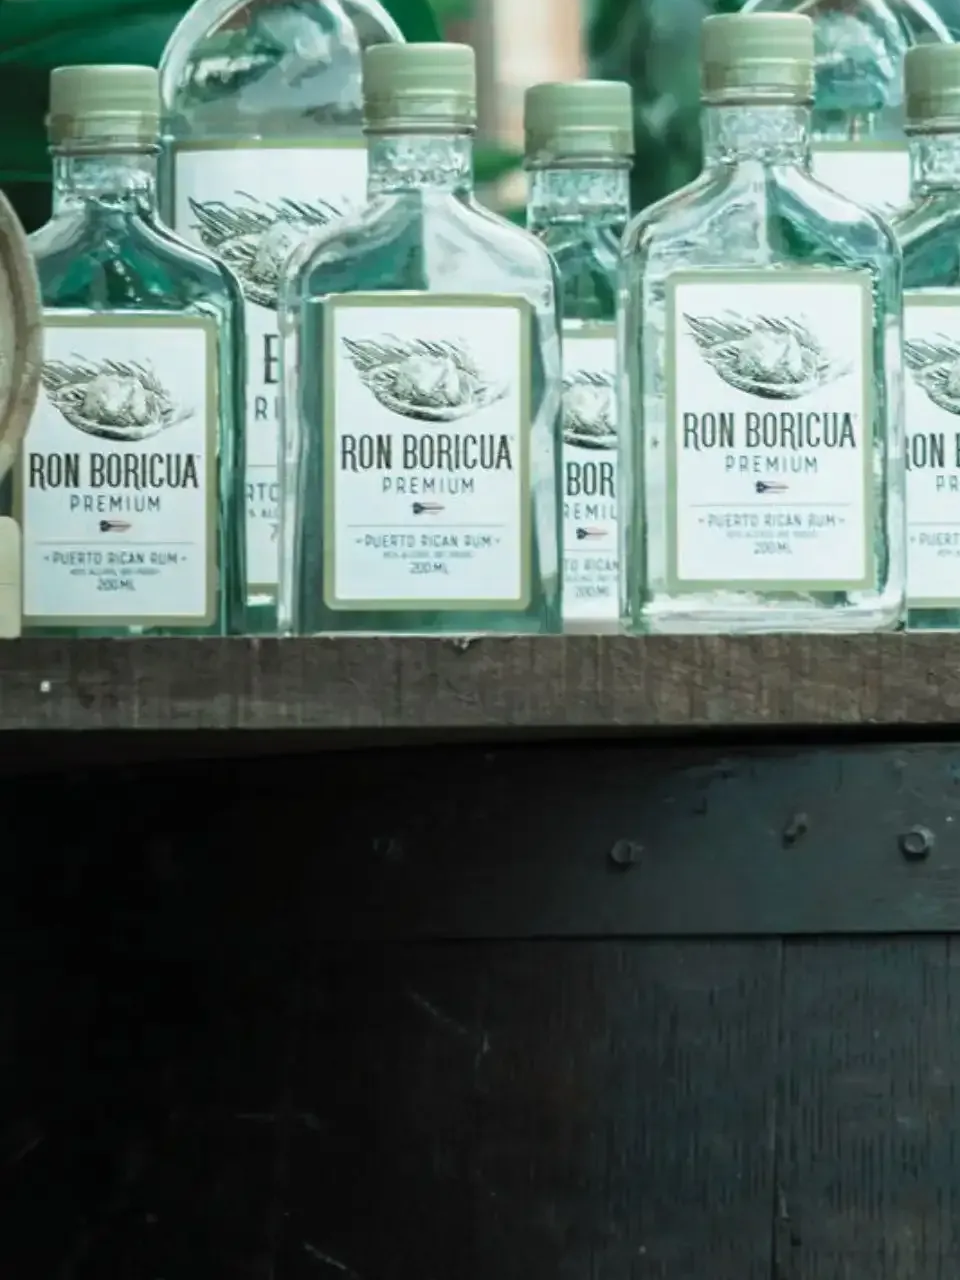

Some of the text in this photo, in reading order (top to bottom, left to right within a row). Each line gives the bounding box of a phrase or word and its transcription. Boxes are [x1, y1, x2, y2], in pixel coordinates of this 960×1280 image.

[683, 412, 856, 451] RON BORICUA
[340, 434, 513, 472] RON BORICUA
[29, 453, 199, 491] RON BORICUA
[725, 455, 818, 473] PREMIUM
[383, 477, 475, 494] PREMIUM
[567, 462, 616, 498] BOR
[70, 495, 160, 512] PREMIUM
[808, 513, 835, 527] RUM
[365, 533, 492, 548] PUERTO RICAN RUM
[53, 551, 178, 565] PUERTO RICAN RUM
